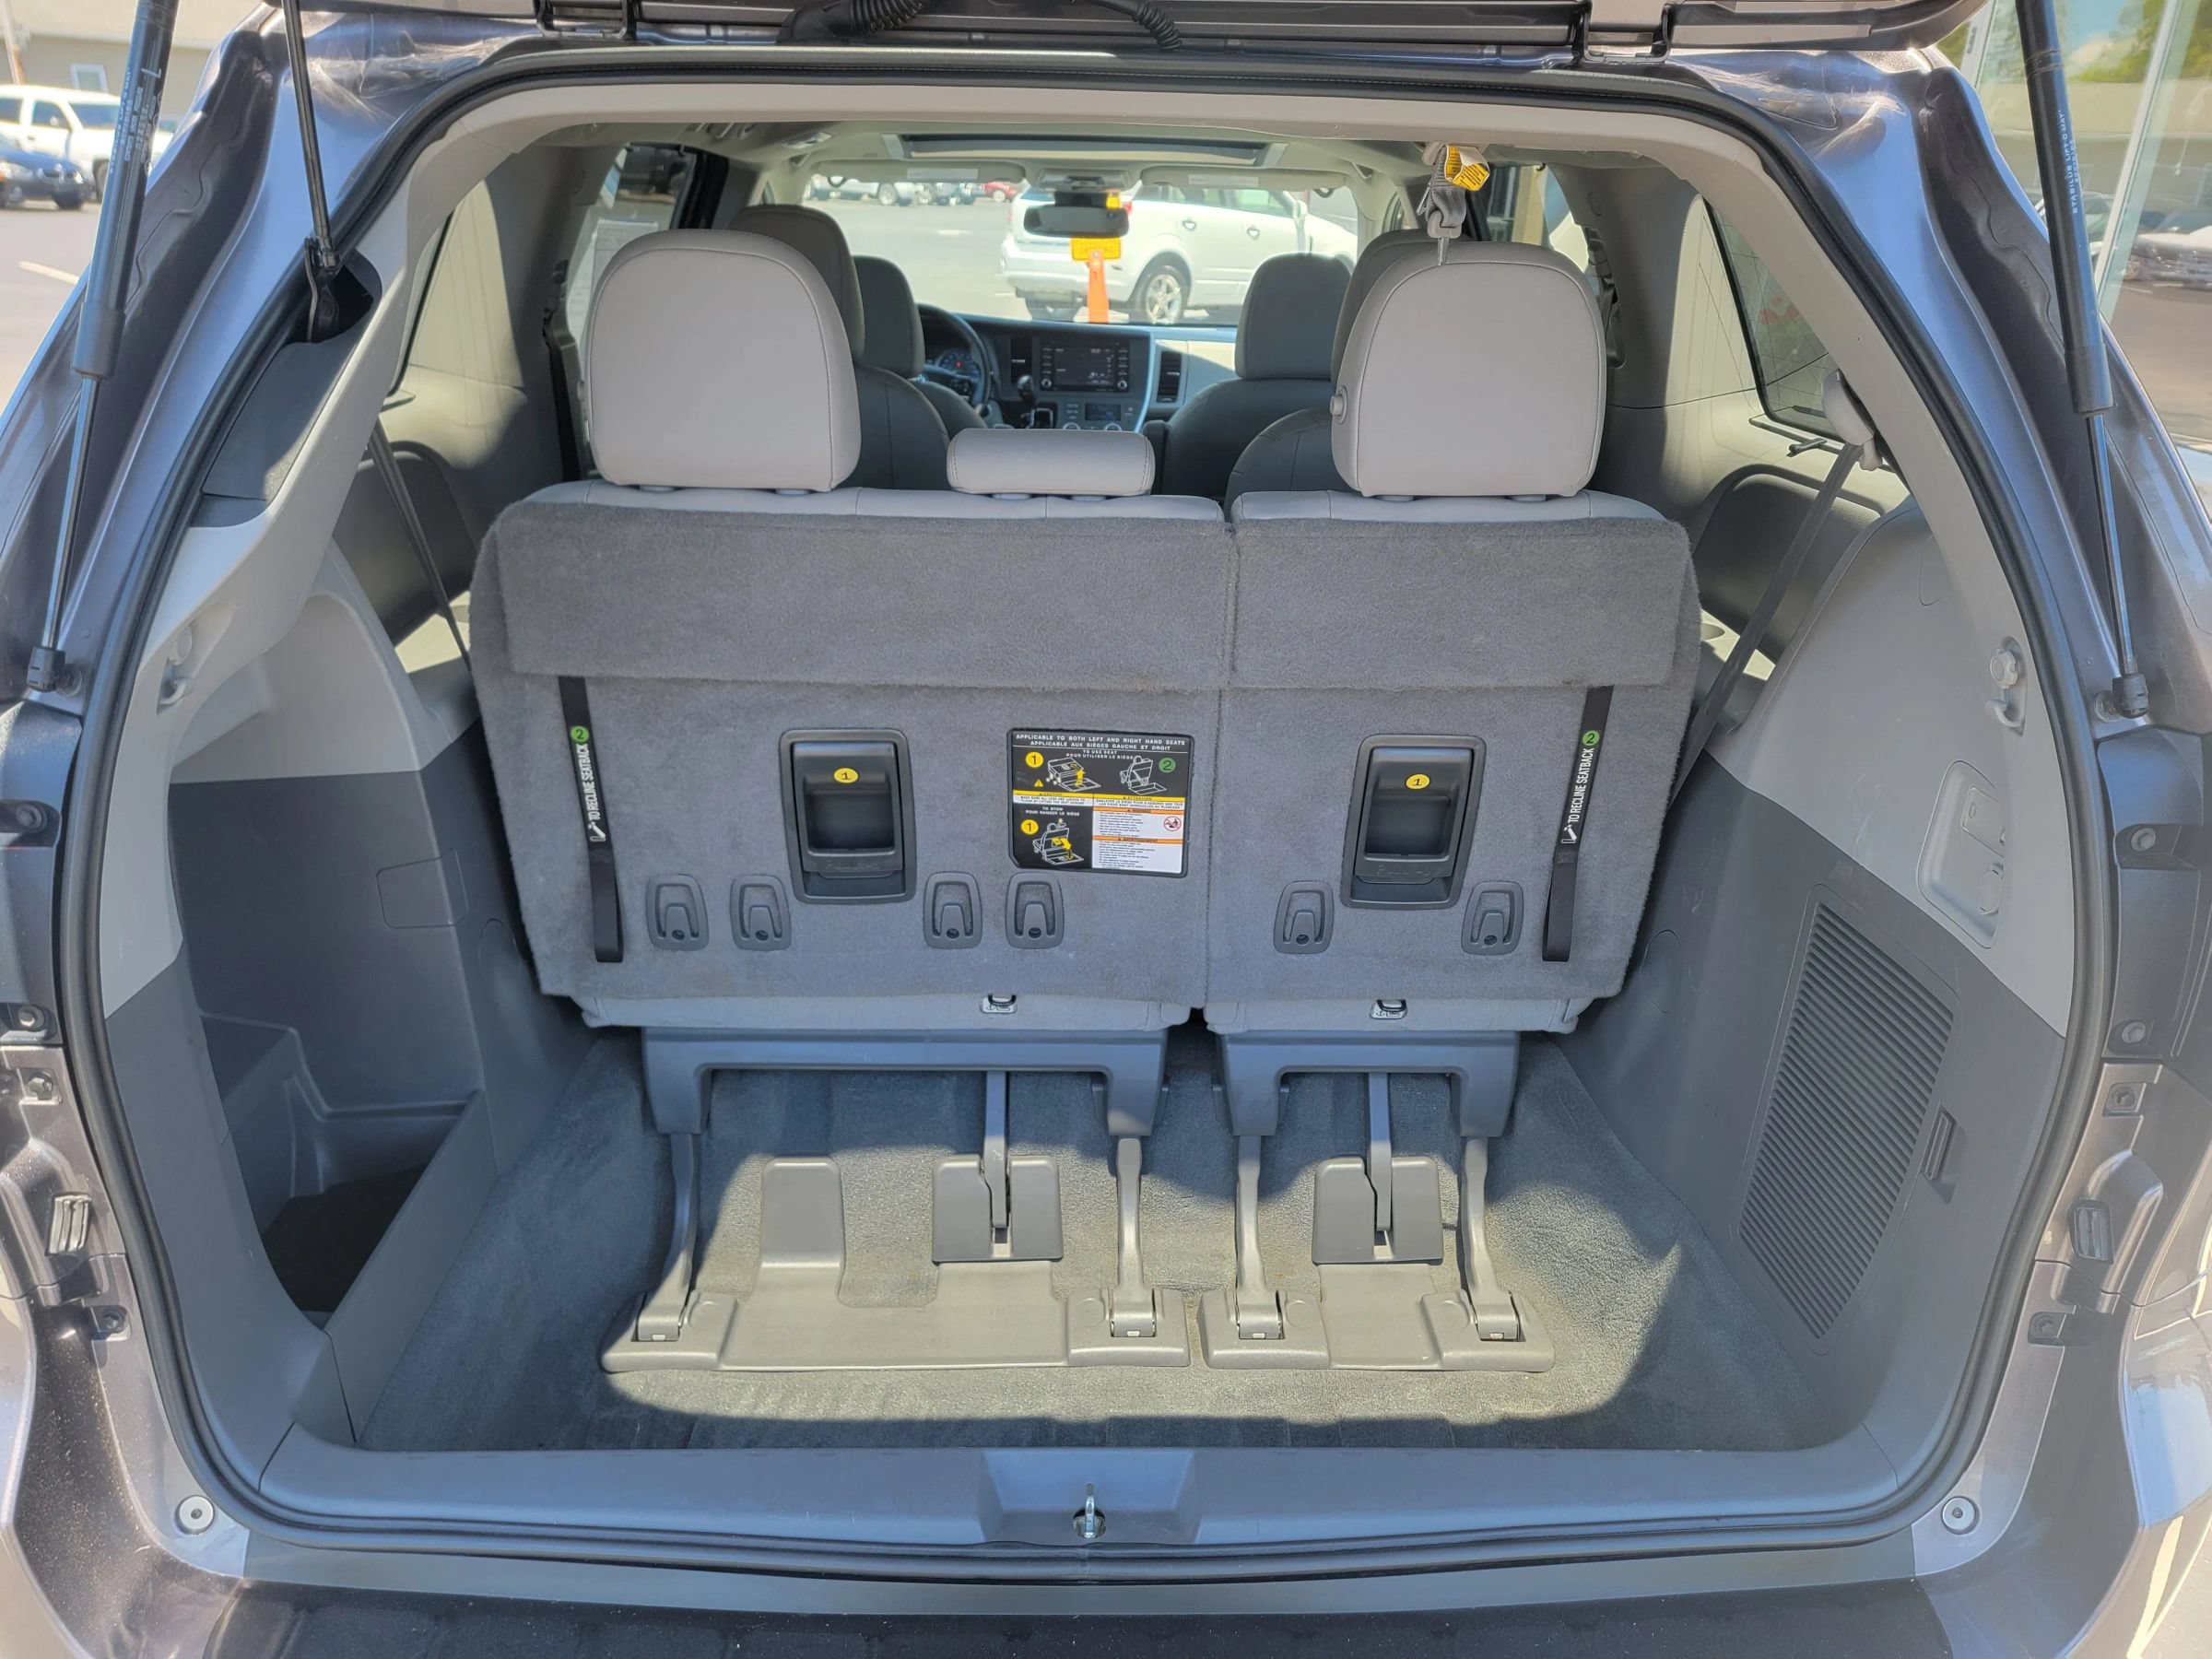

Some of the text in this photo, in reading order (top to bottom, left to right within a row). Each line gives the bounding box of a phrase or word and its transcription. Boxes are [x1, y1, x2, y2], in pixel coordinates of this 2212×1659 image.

[575, 728, 584, 740] 2
[1585, 733, 1595, 744] 2
[1163, 759, 1172, 771] 2
[576, 743, 601, 821] TO RECLINE SEATBACK
[1568, 747, 1594, 824] TO RECLINE SEATBACK
